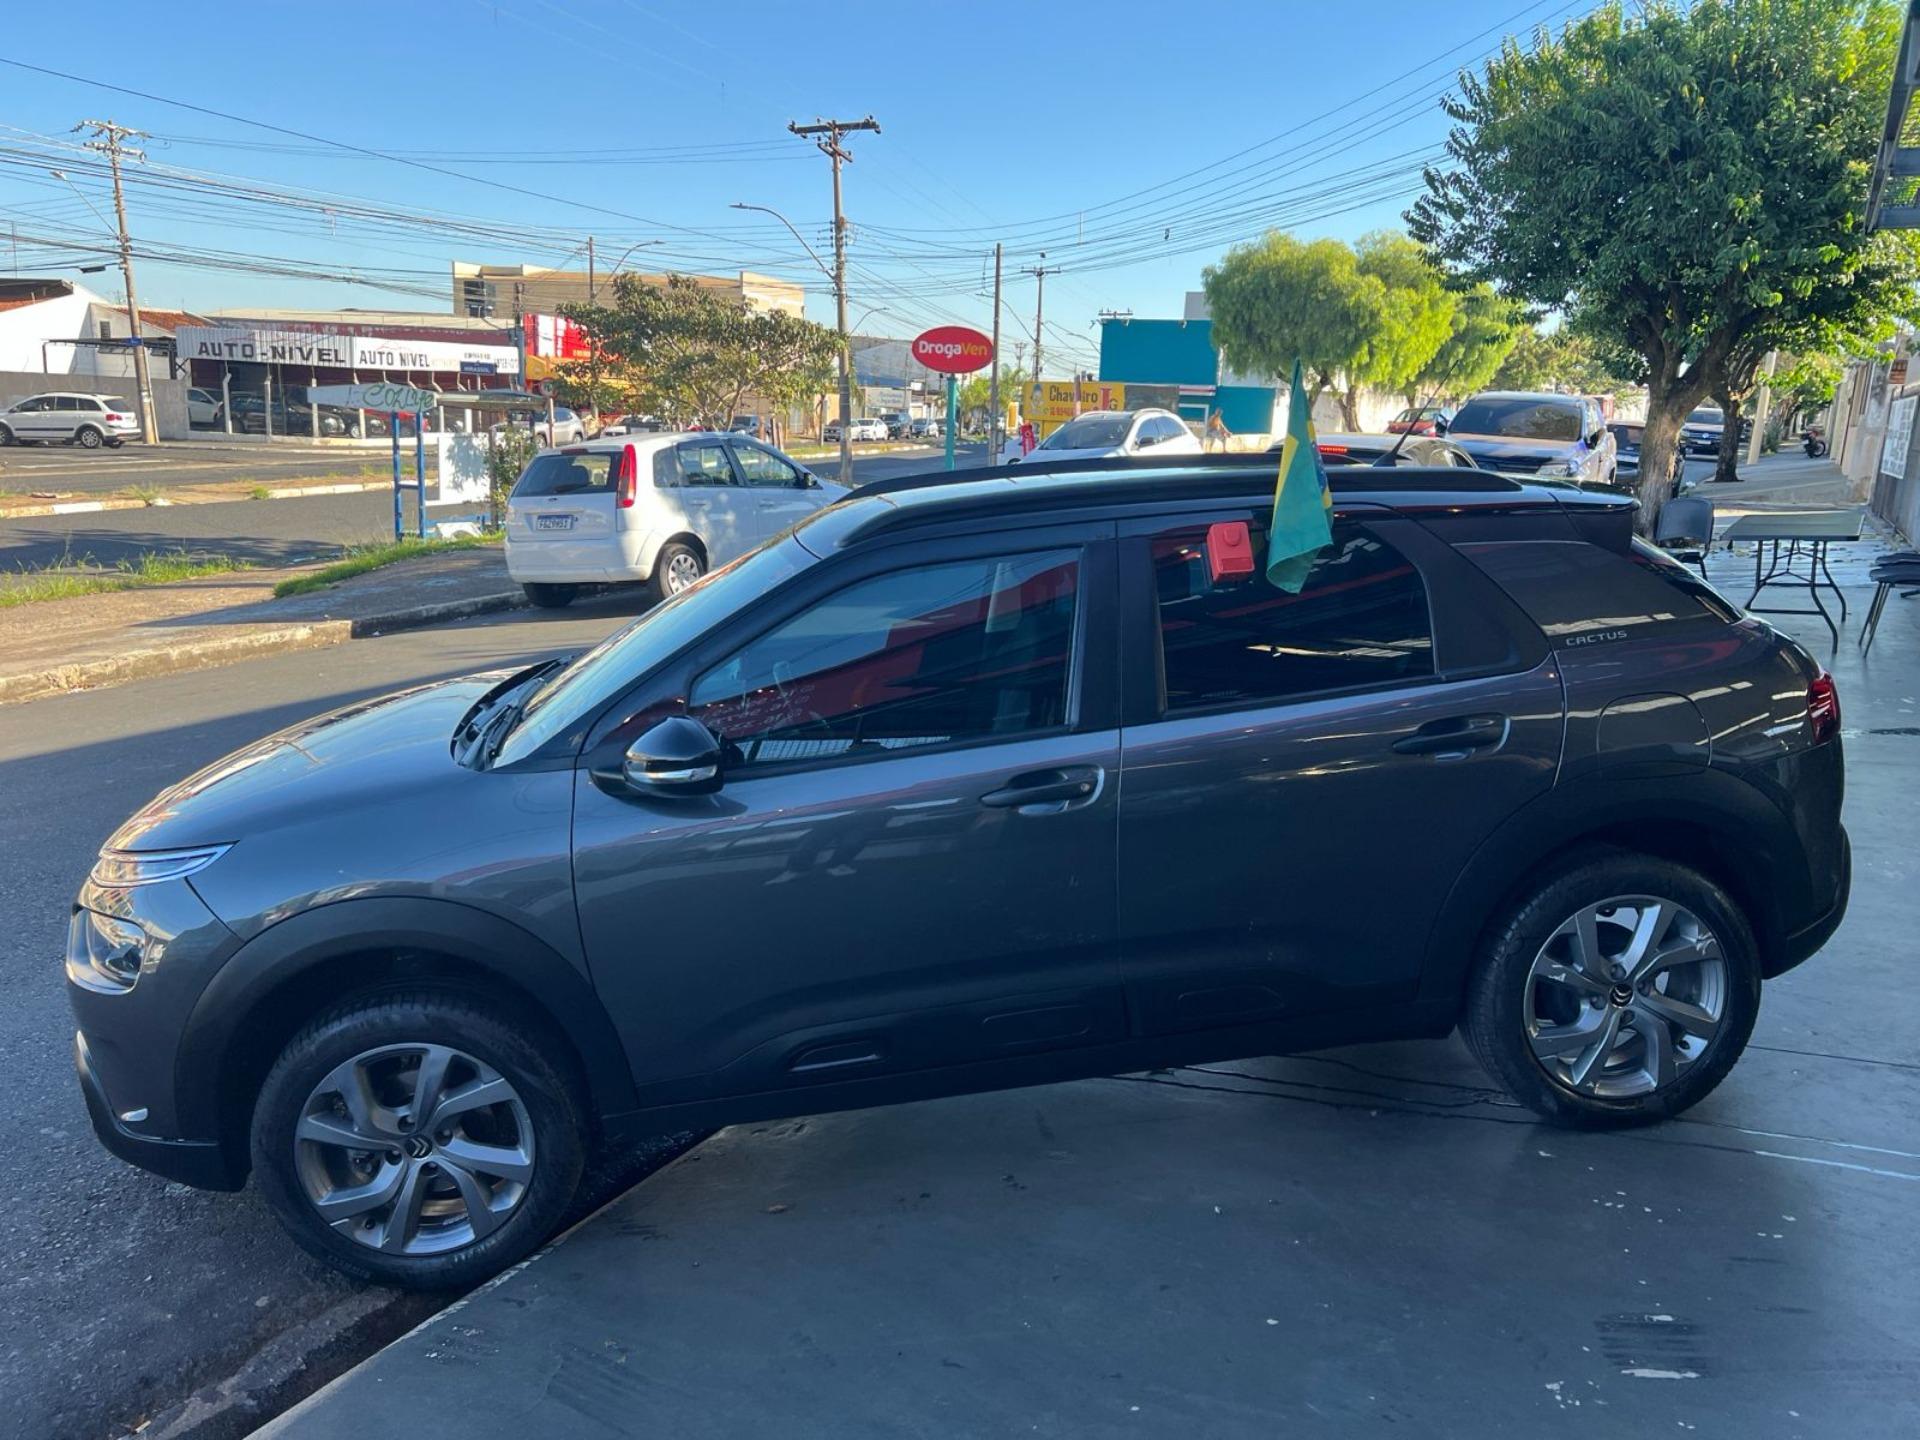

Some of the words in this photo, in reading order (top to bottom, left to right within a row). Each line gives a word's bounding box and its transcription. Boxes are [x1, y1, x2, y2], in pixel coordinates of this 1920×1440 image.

[918, 340, 988, 359] DrogaVen
[359, 350, 394, 366] AUTO
[399, 352, 430, 368] NIVEL
[1049, 385, 1098, 402] Chaviro
[1566, 630, 1628, 646] CACTUS
